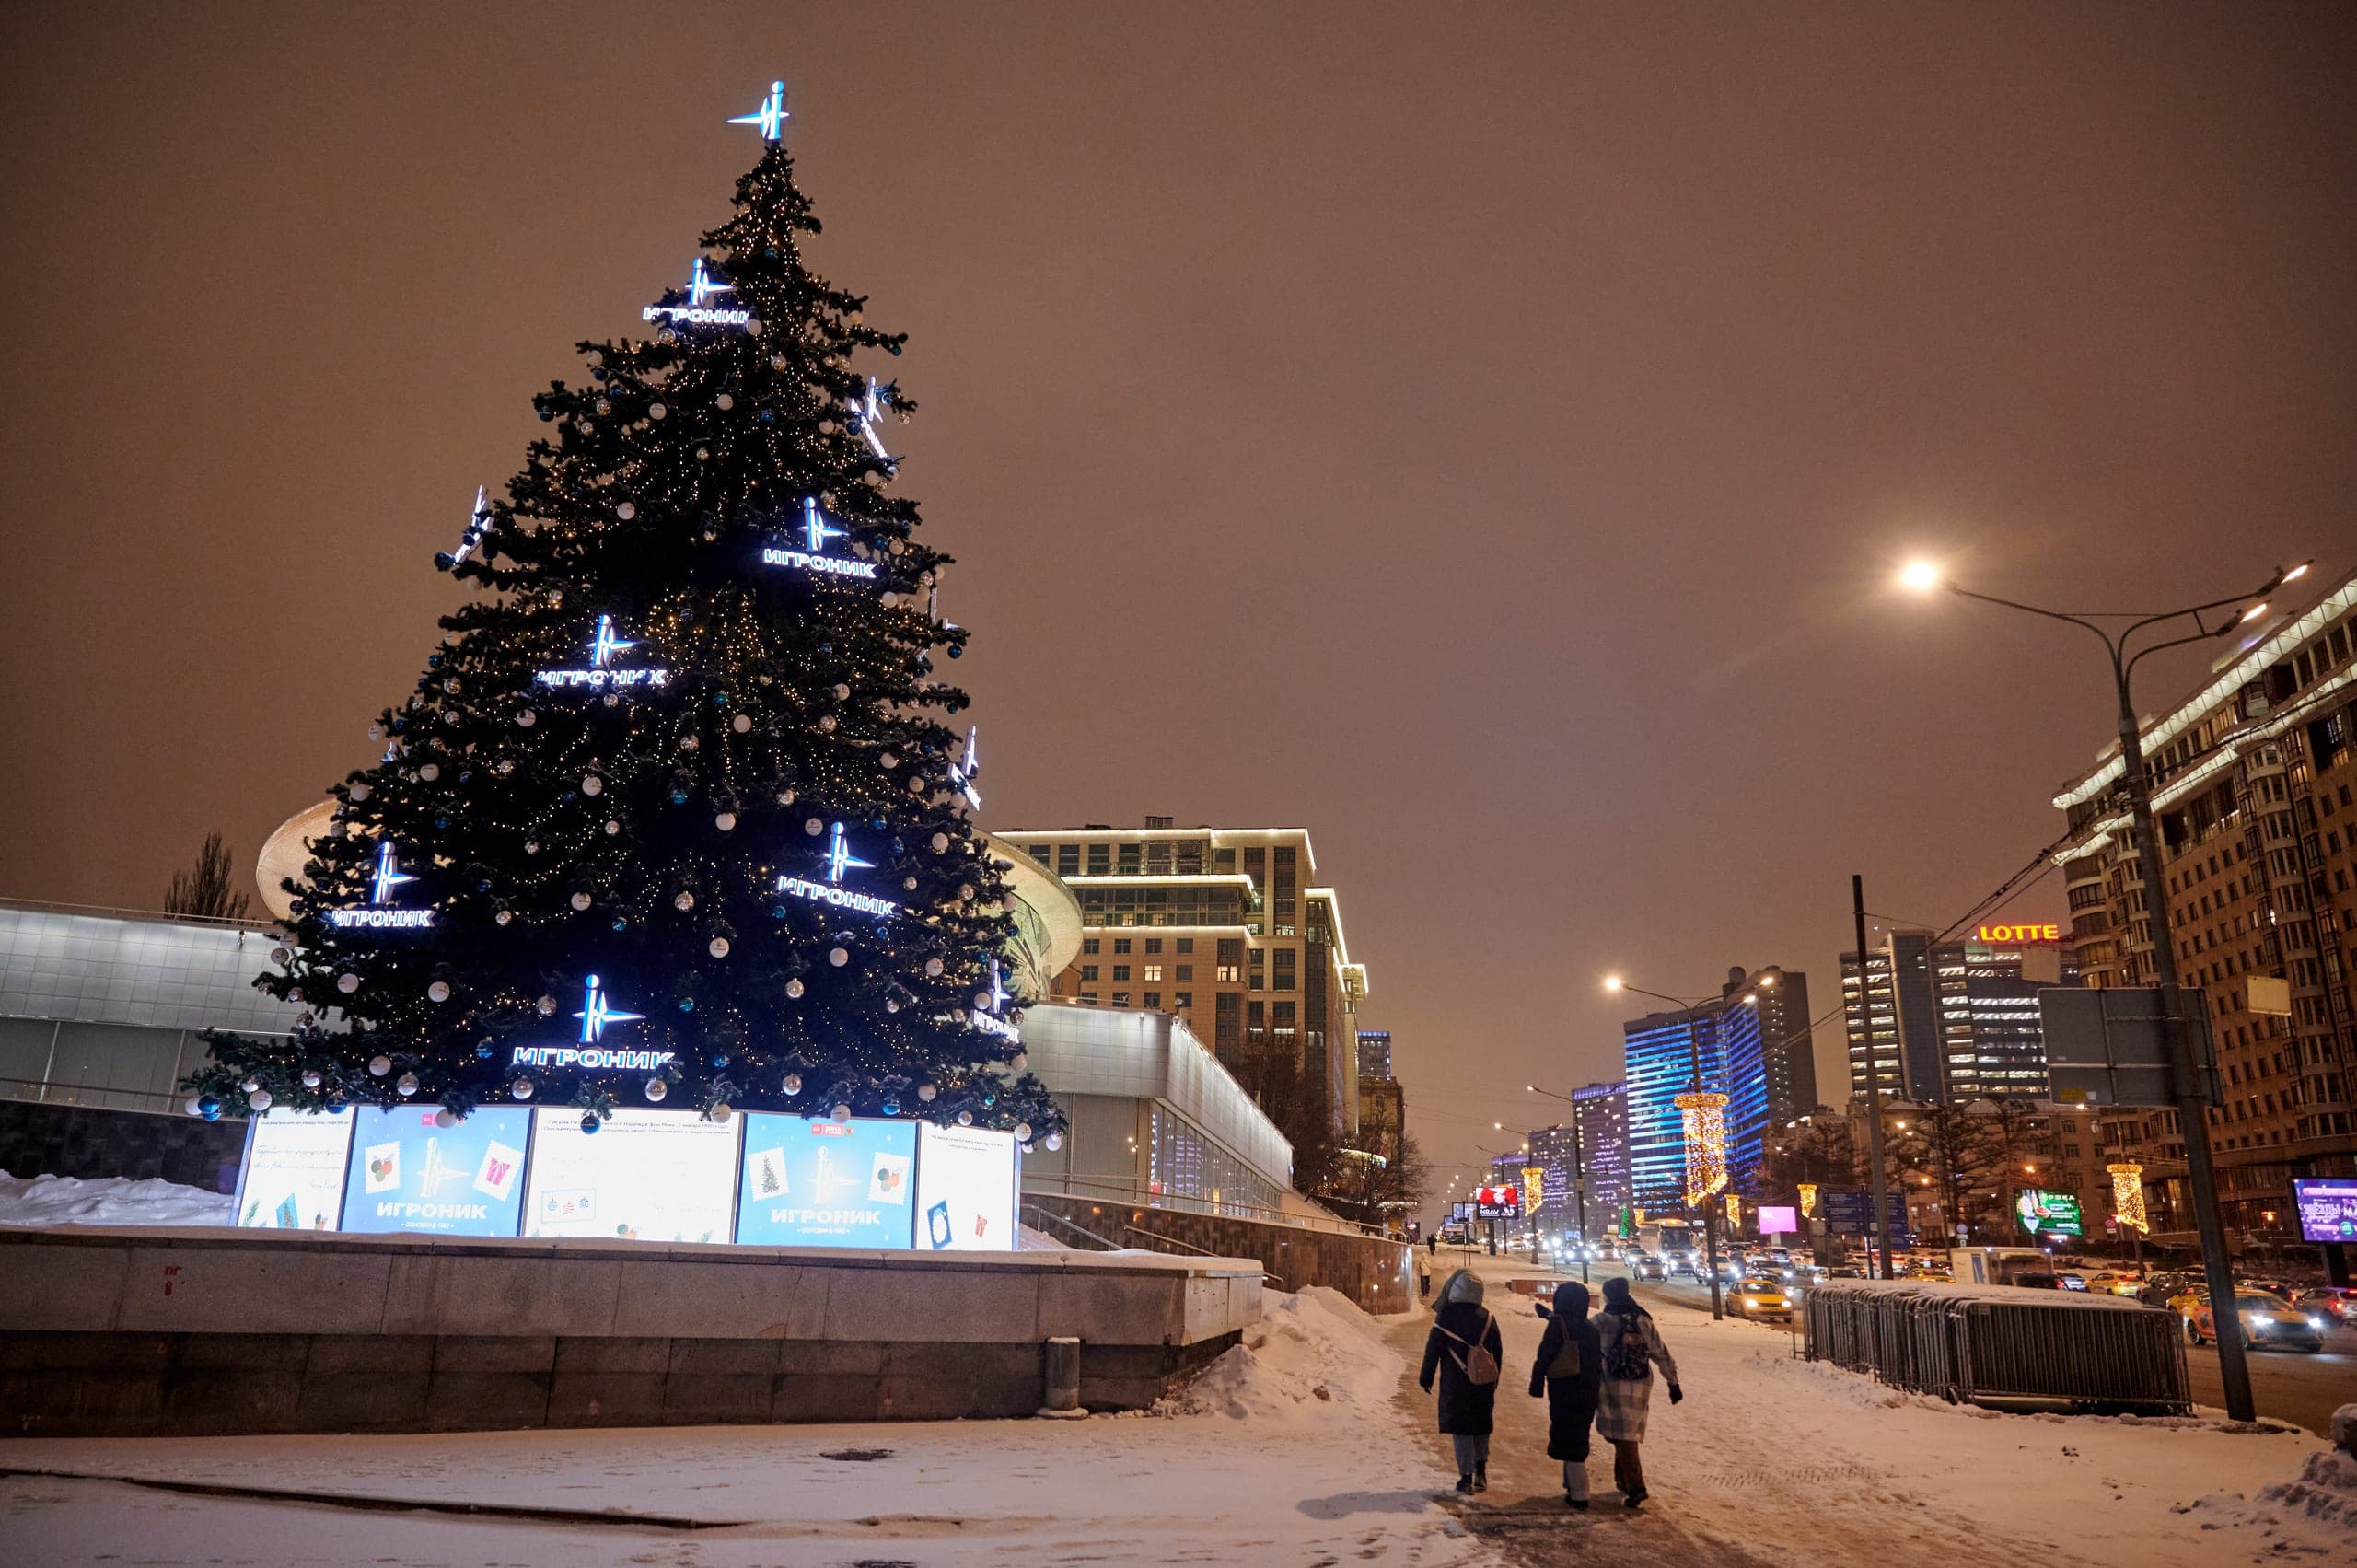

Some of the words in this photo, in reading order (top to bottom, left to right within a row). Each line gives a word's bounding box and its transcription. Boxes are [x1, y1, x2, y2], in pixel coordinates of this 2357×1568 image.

[763, 548, 877, 579] ИГРОНИК
[537, 669, 668, 686] ИГРОНИК
[777, 875, 897, 915] ИГРОНИК
[331, 910, 434, 927] ИГРОНИК
[1980, 924, 2059, 942] LOTTE
[513, 1046, 675, 1070] ИГРОНИК
[376, 1202, 488, 1220] ИГРОНИК
[771, 1208, 882, 1225] ИГРОНИК
